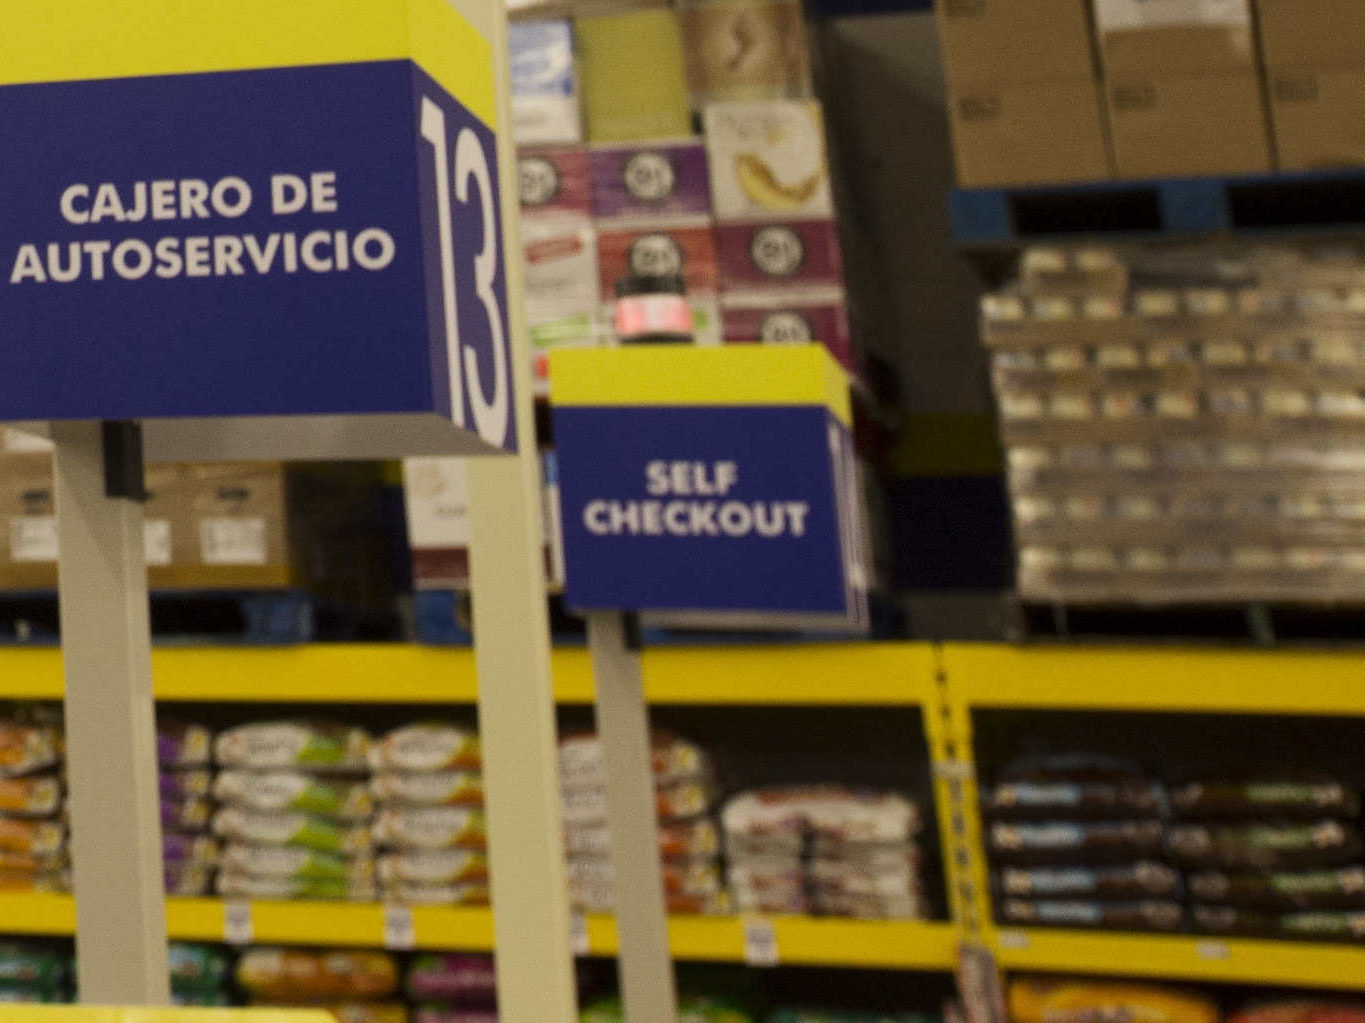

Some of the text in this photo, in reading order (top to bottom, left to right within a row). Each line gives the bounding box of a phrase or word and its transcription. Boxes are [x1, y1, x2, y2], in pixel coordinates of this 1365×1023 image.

[60, 172, 338, 224] CAJERO DE
[10, 228, 396, 284] AUTOSERVICIO
[421, 95, 508, 448] 13
[645, 460, 737, 496] SELF
[583, 500, 810, 537] CHECKOUT
